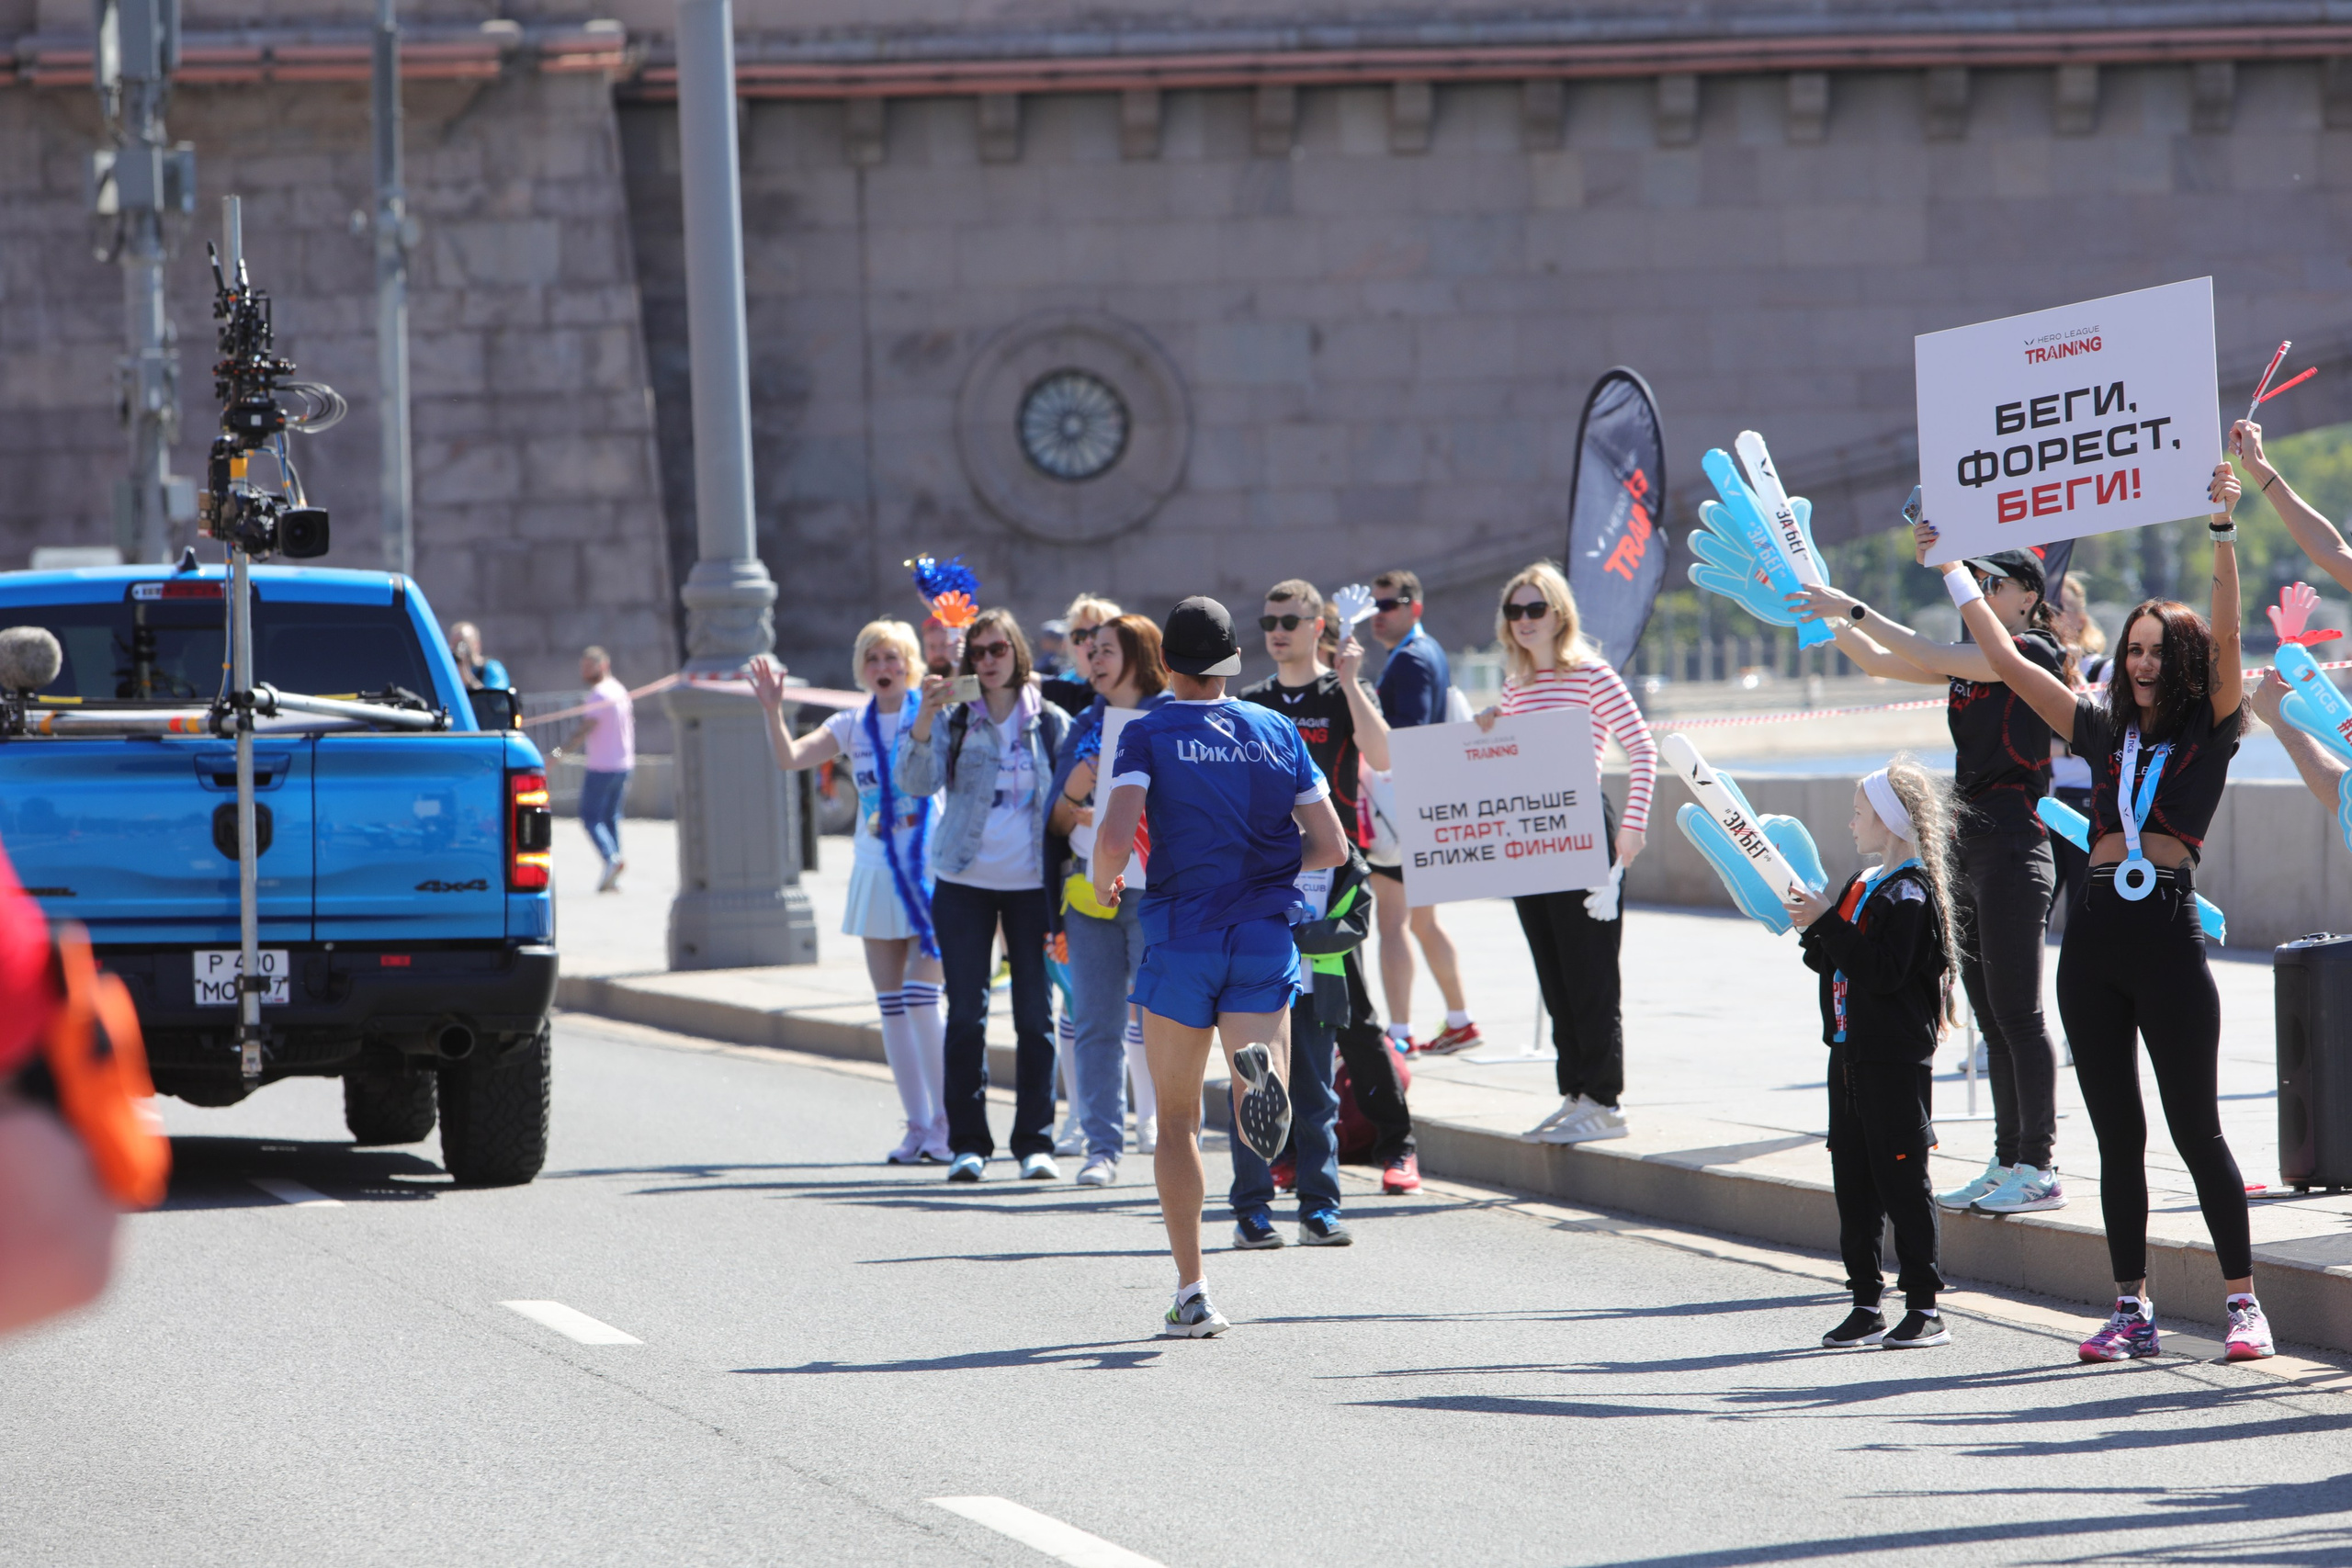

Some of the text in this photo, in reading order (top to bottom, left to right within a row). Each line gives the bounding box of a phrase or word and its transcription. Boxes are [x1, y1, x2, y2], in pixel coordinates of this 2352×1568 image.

[2038, 324, 2100, 344] HERO LEAGUE
[2025, 336, 2102, 365] TRAINING
[1996, 380, 2137, 436] БЕГИ,
[1957, 416, 2181, 489] ФОРЕСТ,
[1996, 467, 2142, 525] БЕГИ!
[2310, 682, 2340, 716] ПСБ
[1464, 744, 1519, 761] TRAINING
[1419, 790, 1577, 821] ЧЕМ ДАЛЬШЕ
[1519, 814, 1566, 834] ТЕМ
[1414, 834, 1593, 868] БЛИЖЕ ФИНИШ
